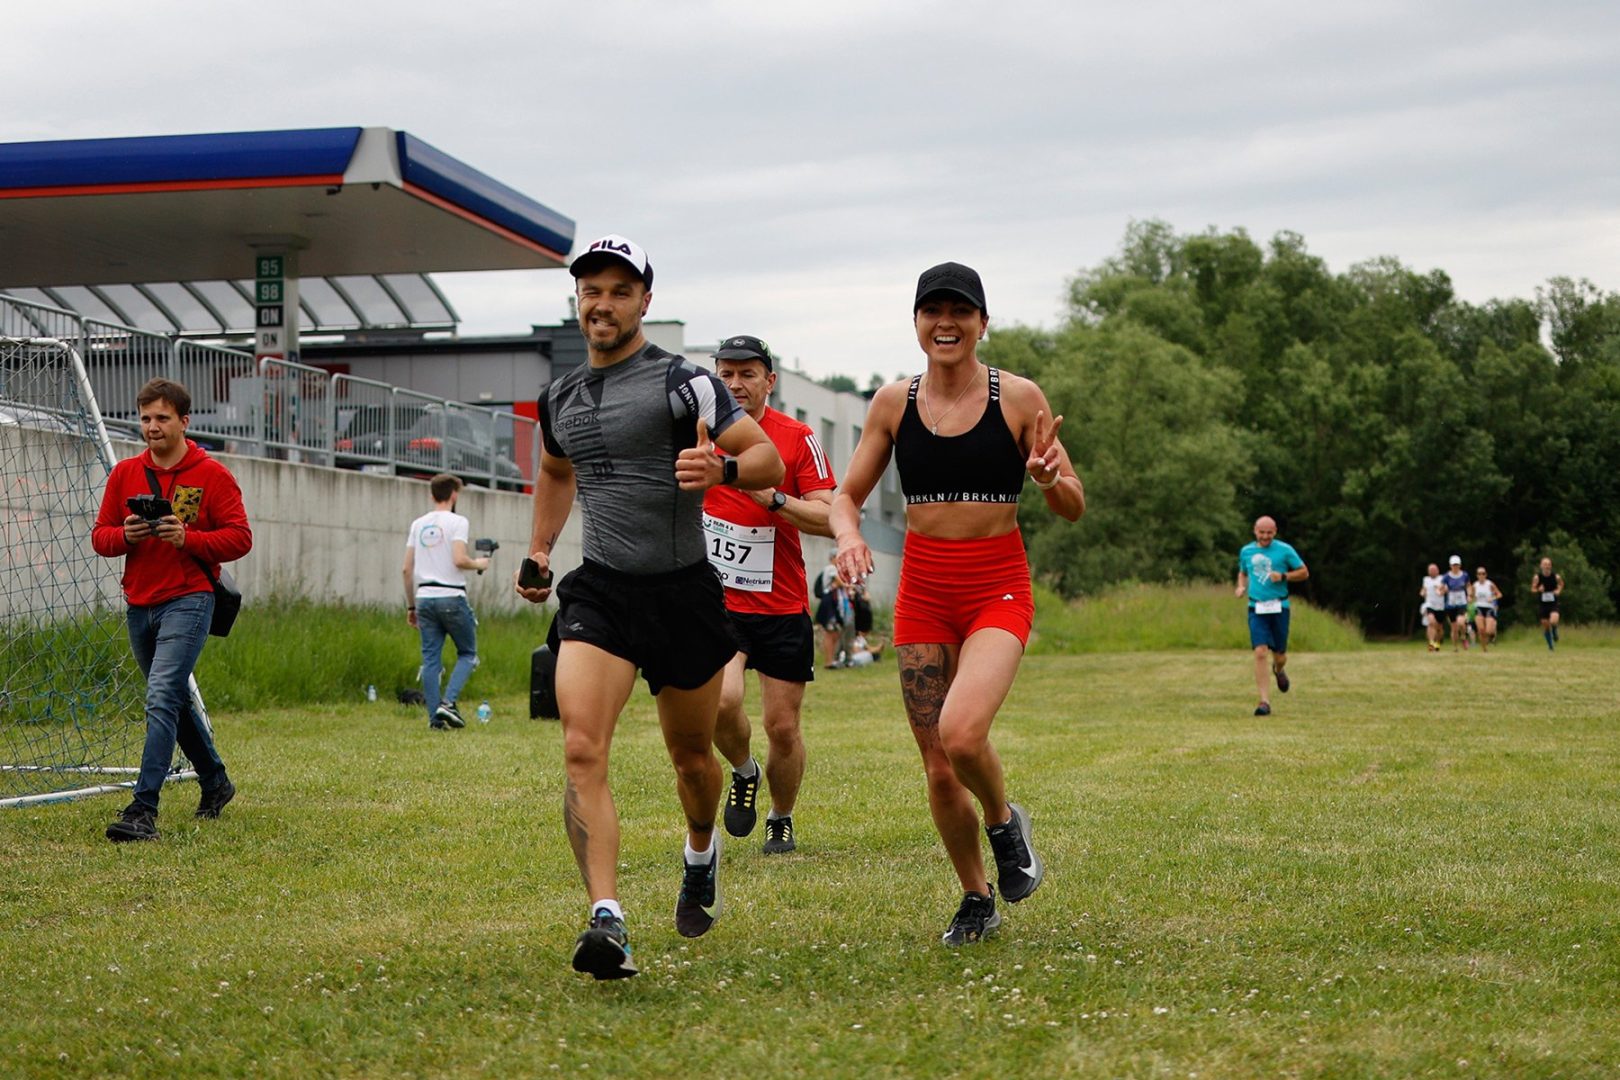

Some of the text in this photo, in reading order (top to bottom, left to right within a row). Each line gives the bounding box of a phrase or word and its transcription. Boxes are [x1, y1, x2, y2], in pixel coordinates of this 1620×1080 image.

[589, 239, 631, 255] FILA
[261, 260, 279, 275] 95
[261, 284, 279, 300] 98
[261, 308, 279, 324] ON
[262, 333, 278, 346] ON
[962, 492, 1006, 502] BRKLN
[711, 537, 752, 565] 157
